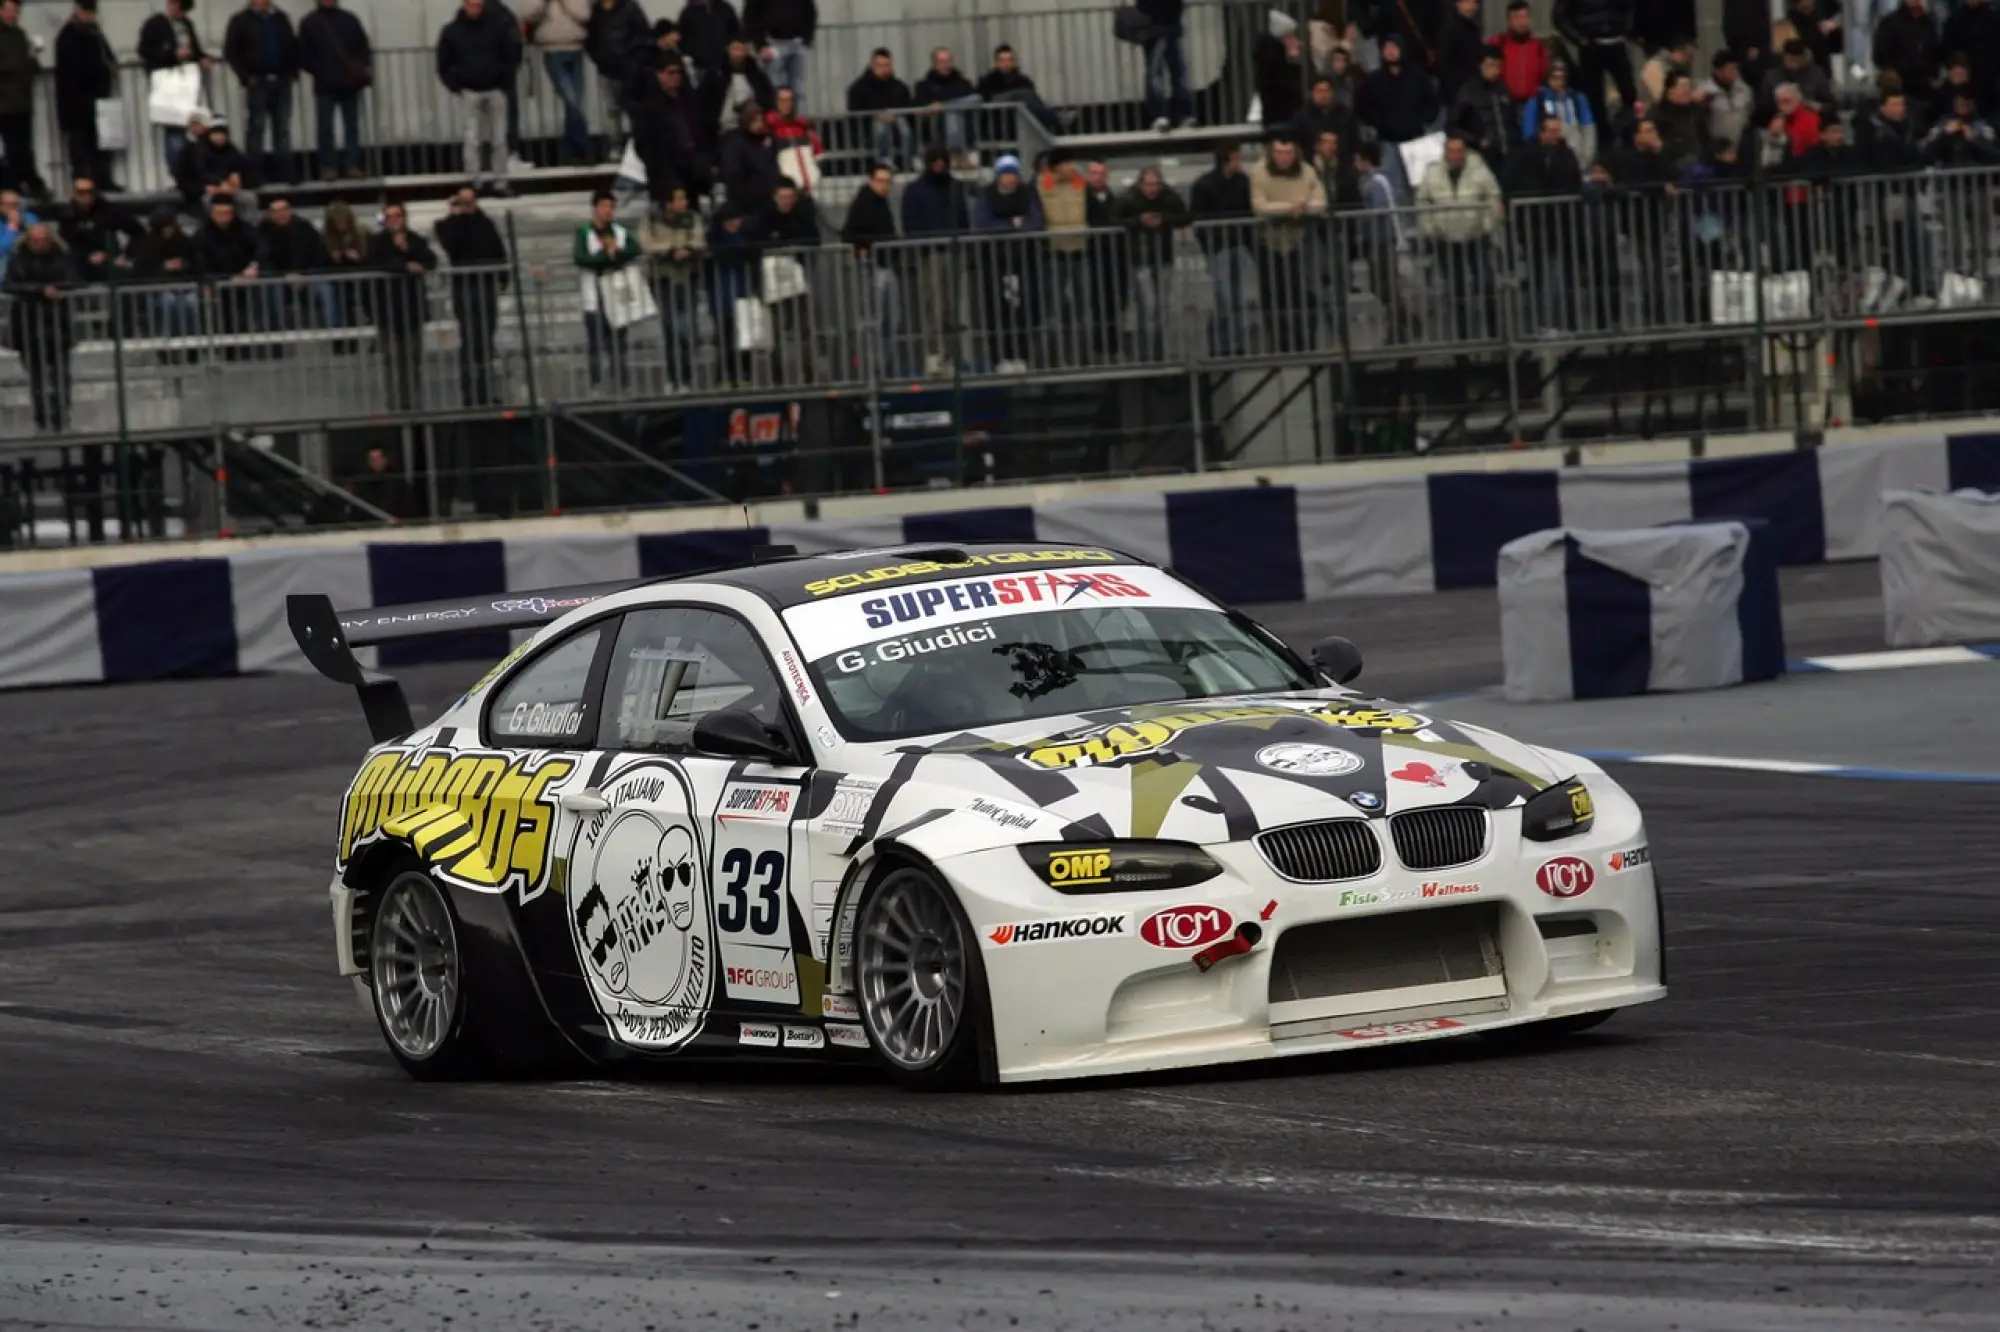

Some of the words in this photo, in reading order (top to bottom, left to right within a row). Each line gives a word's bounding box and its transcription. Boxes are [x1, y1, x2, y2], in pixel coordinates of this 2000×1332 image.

[861, 572, 1151, 629] SUPERSTARS
[377, 607, 476, 625] ENERGY
[836, 622, 996, 674] G.Giudici
[613, 776, 665, 808] ITALIANO
[725, 786, 790, 813] SUPERSTARS
[1049, 852, 1111, 879] OMP
[718, 847, 785, 935] 33
[1421, 881, 1481, 898] Wellness
